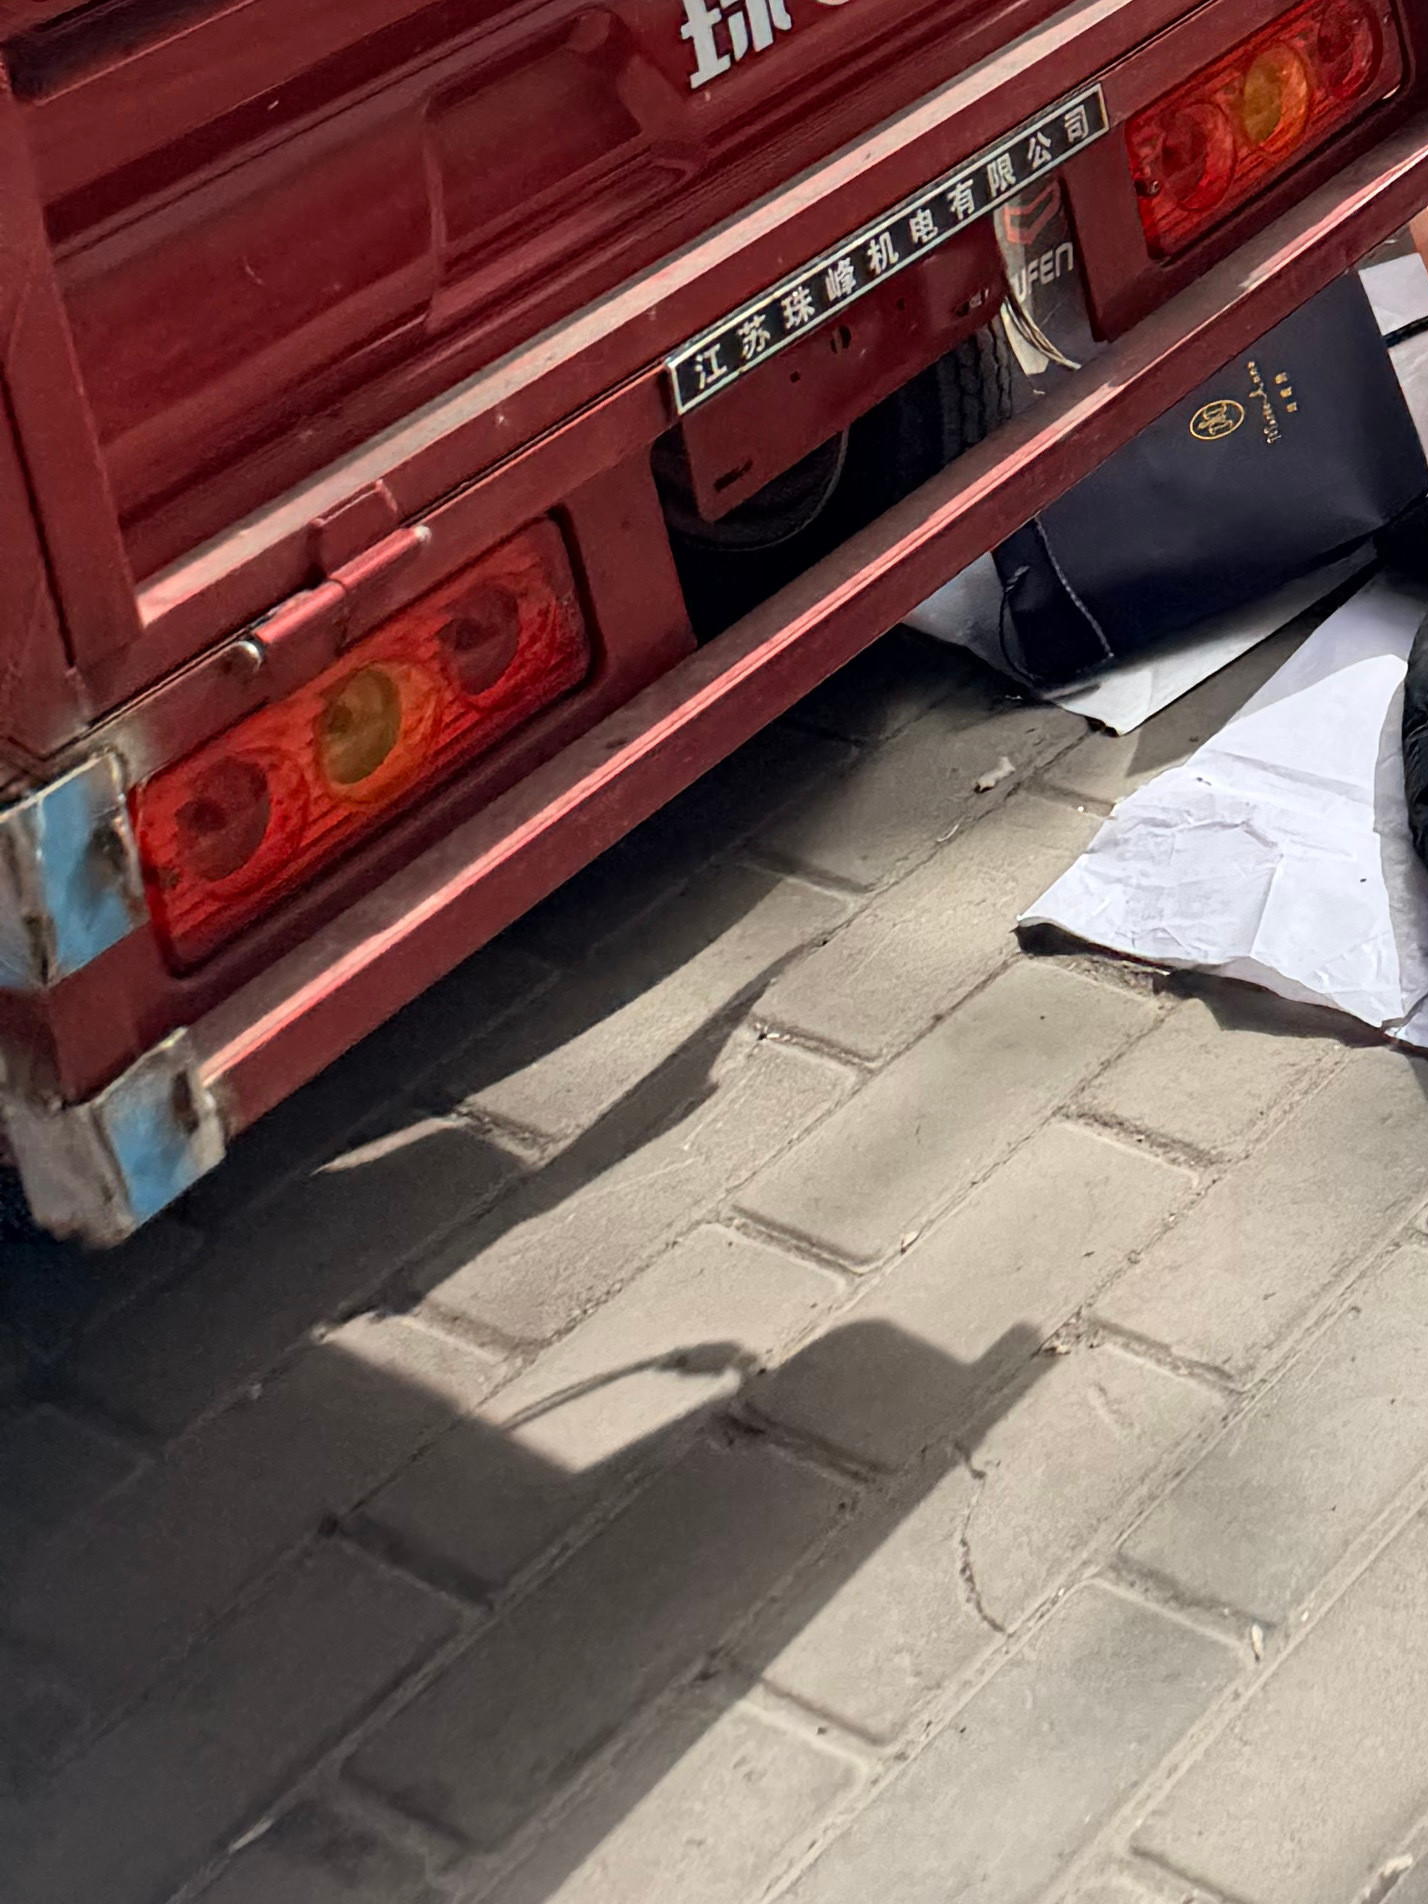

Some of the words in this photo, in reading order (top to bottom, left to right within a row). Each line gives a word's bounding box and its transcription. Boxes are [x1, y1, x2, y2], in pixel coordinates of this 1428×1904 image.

[695, 106, 1091, 391] 江苏珠峰机电有限公司
